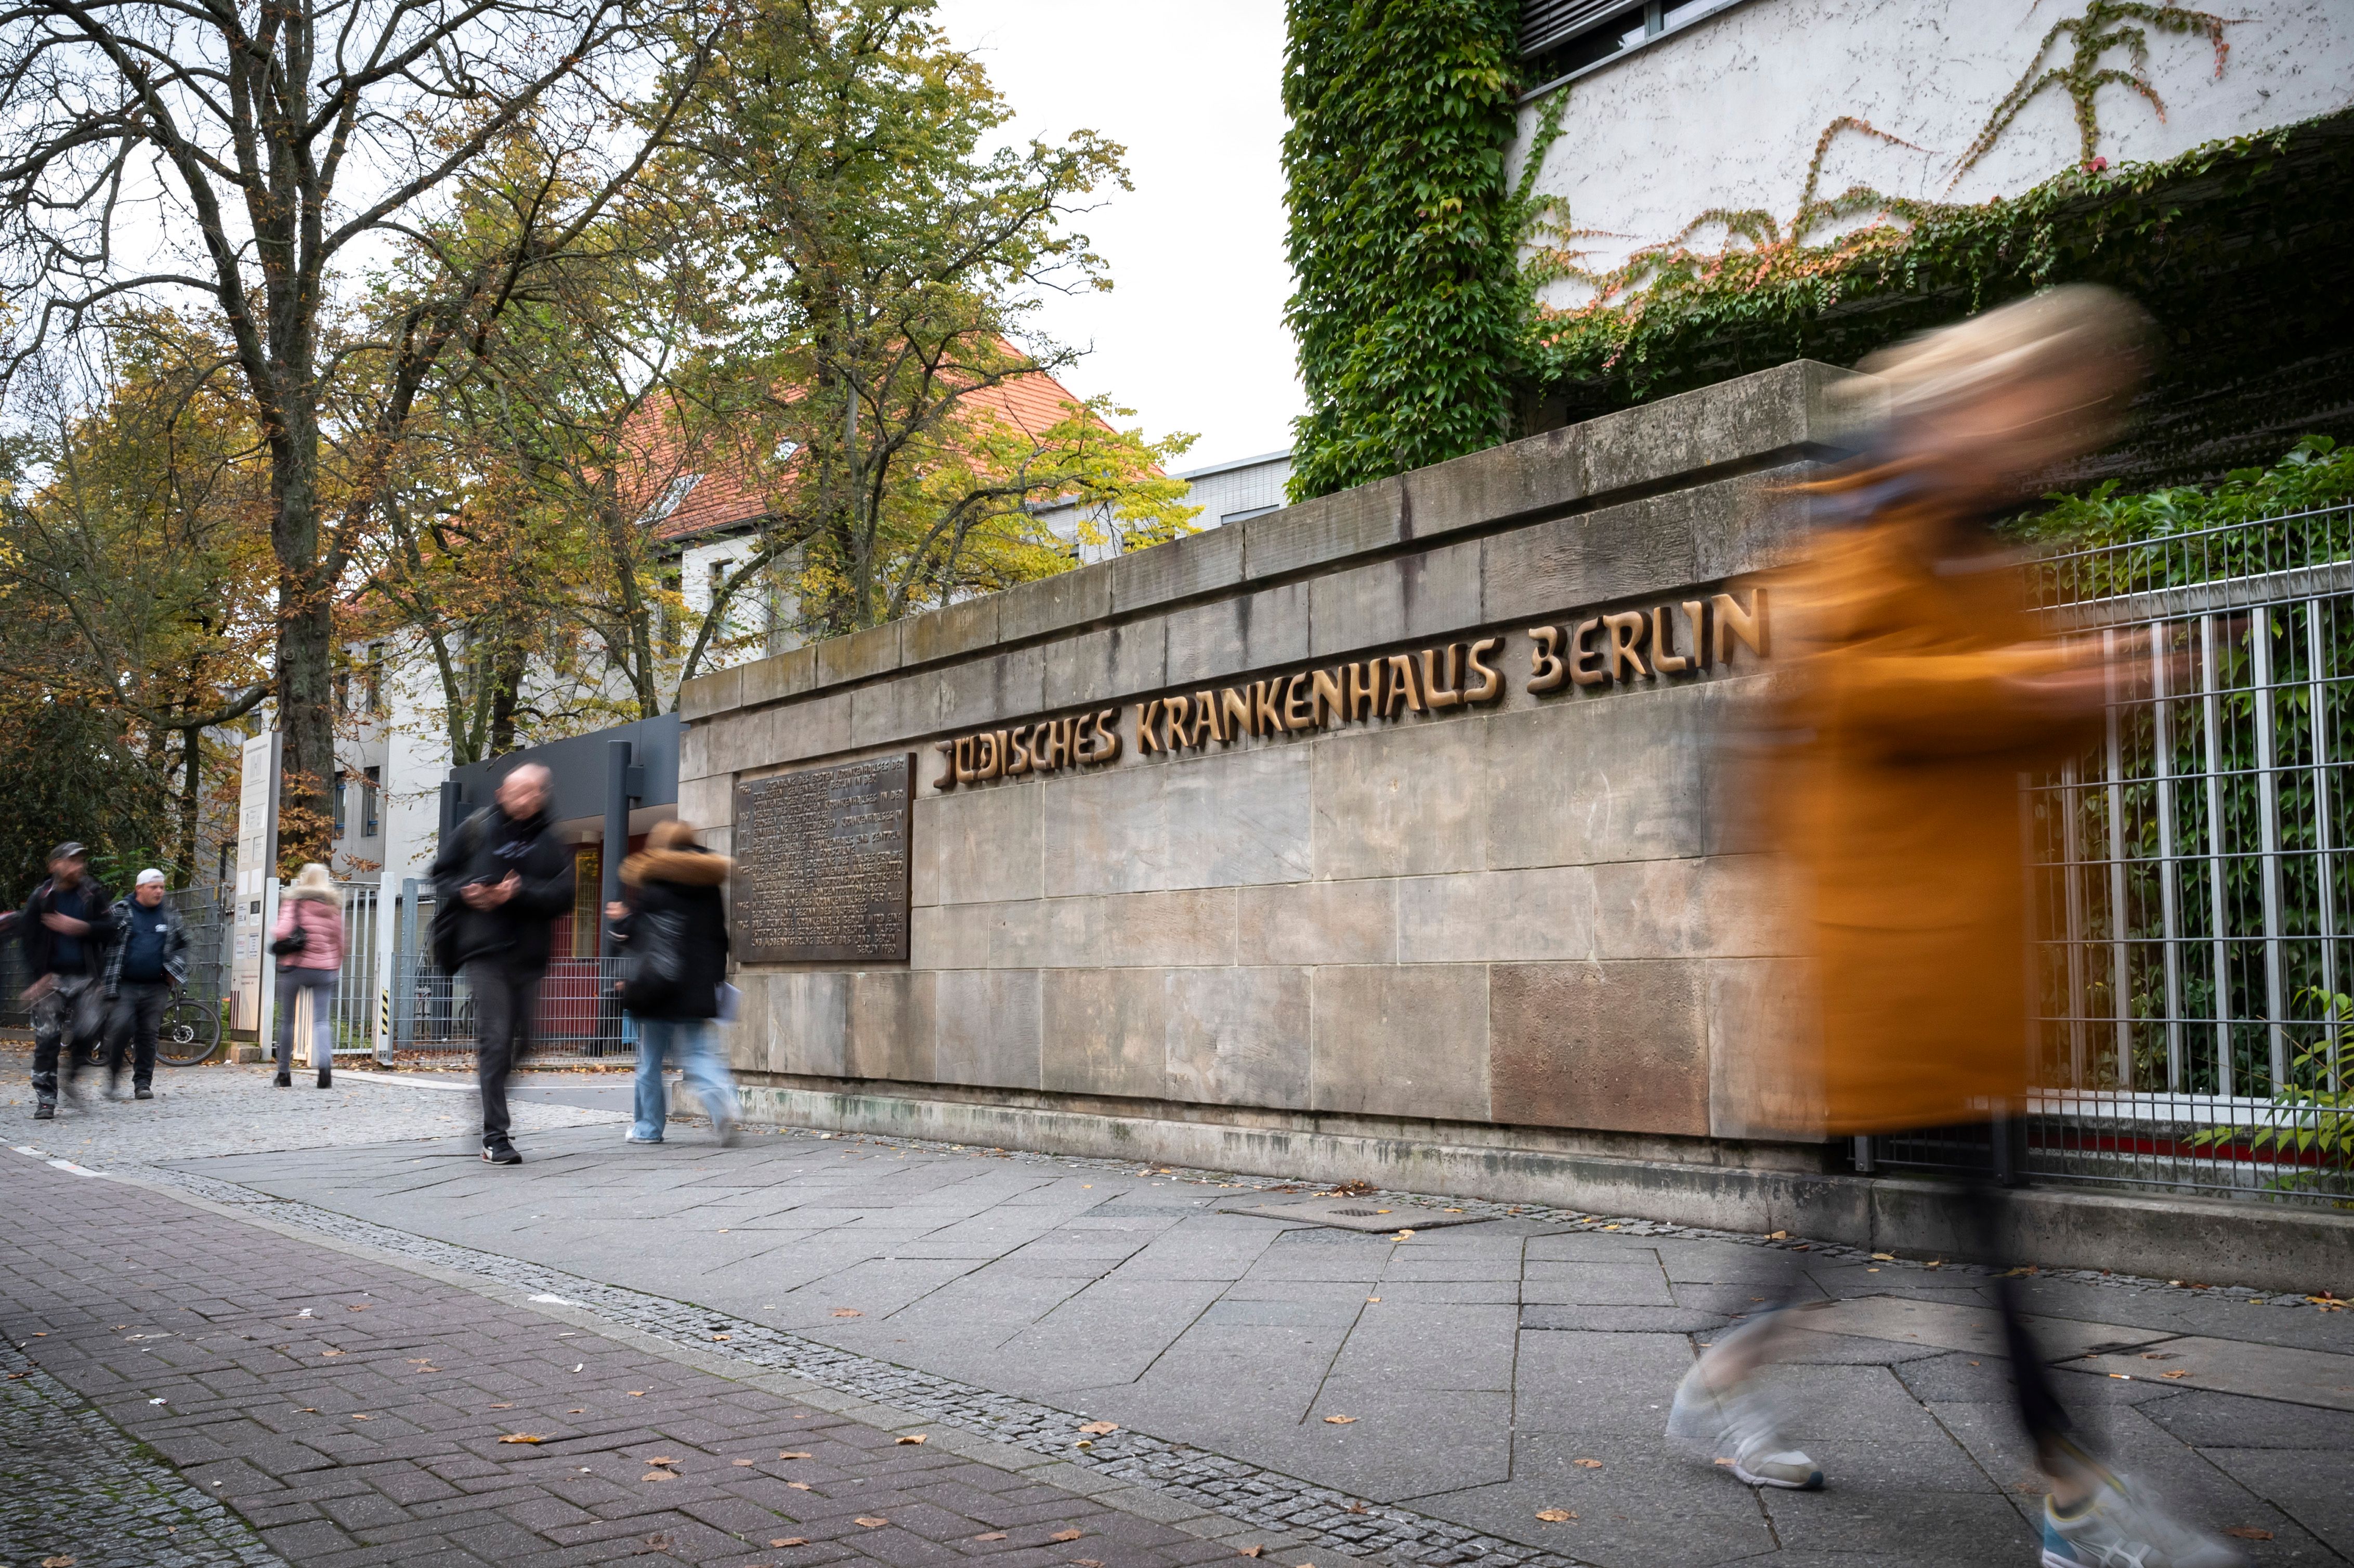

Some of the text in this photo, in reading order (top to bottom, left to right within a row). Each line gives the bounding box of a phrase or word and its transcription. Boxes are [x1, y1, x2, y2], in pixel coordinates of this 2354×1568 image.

[933, 588, 1768, 788] JÜDISCHES KRANKENHAUS BERLIN
[798, 774, 809, 785] DES
[811, 770, 833, 783] ERSTEN
[838, 761, 888, 779] KRANKENHAUSES
[891, 757, 904, 770] DER
[788, 782, 816, 796] GEMEINDE
[830, 777, 852, 790] BERLIN
[855, 775, 861, 786] IN
[863, 773, 876, 785] DER
[777, 806, 787, 816] DES
[825, 792, 877, 809] KRANKENHAUSES
[880, 791, 888, 802] IN
[890, 788, 904, 801] DER
[802, 790, 827, 803] STRASSE
[792, 822, 802, 833] DES
[841, 810, 893, 827] KRANKENHAUSES
[896, 808, 903, 820] IN
[802, 829, 828, 841] STRASSE
[809, 835, 853, 849] KRANKENHAUS
[856, 833, 868, 844] UND
[871, 829, 903, 842] ZENTRUM
[819, 845, 855, 858] FORSCHUNG
[838, 855, 848, 866] DES
[852, 853, 875, 865] HAUSES
[892, 850, 903, 861] DIE
[807, 865, 849, 878] ZUNEHMENDEM
[853, 863, 874, 874] MASSE
[877, 860, 902, 872] GHETTO
[752, 882, 763, 892] UND
[821, 873, 864, 886] ABTRANSPORT
[789, 888, 795, 898] IN
[799, 888, 808, 897] DIE
[812, 882, 886, 897] KONZENTRATIONSLAGER
[801, 897, 812, 907] DES
[815, 893, 866, 906] KRANKENHAUSES
[887, 891, 902, 902] ALLE
[752, 904, 868, 919] BERLINER UND BEGINN DES AUFBAUES
[752, 919, 763, 929] DAS
[796, 915, 840, 926] KRANKENHAUS
[843, 913, 864, 924] BERLIN
[868, 912, 884, 923] WIRD
[887, 912, 902, 923] EINE
[751, 933, 896, 947] UND MODERNISIERUNG DURCH DAS LAND BERLIN
[783, 927, 794, 937] DES
[857, 944, 879, 954] BERLIN
